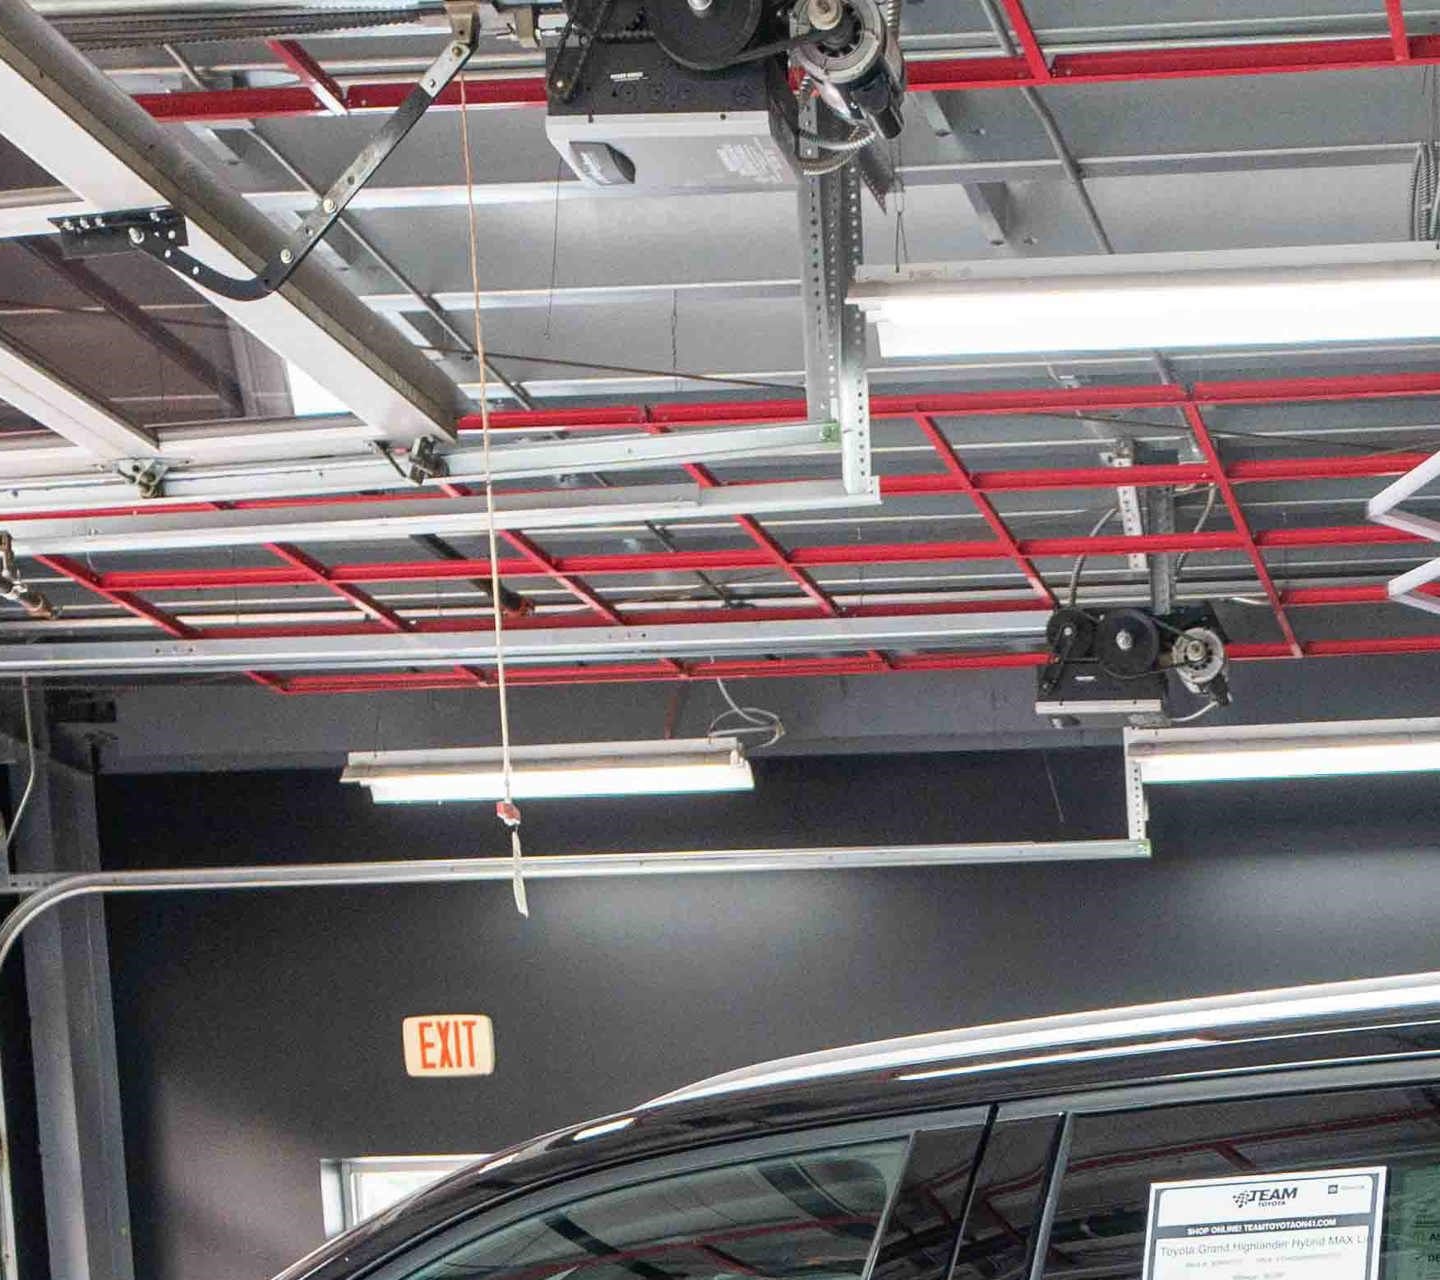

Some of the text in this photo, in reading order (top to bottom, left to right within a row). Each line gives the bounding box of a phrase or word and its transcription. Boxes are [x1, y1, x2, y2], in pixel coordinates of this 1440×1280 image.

[419, 1020, 477, 1070] EXIT
[1248, 1187, 1298, 1202] TEAM
[1187, 1226, 1209, 1236] SHOP
[1211, 1224, 1242, 1235] ONLINE!
[1161, 1243, 1194, 1258] Toyota
[1198, 1241, 1230, 1255] Grand
[1232, 1238, 1288, 1254] Highlander
[1290, 1237, 1326, 1251] Hybrid
[1328, 1235, 1354, 1246] MAX
